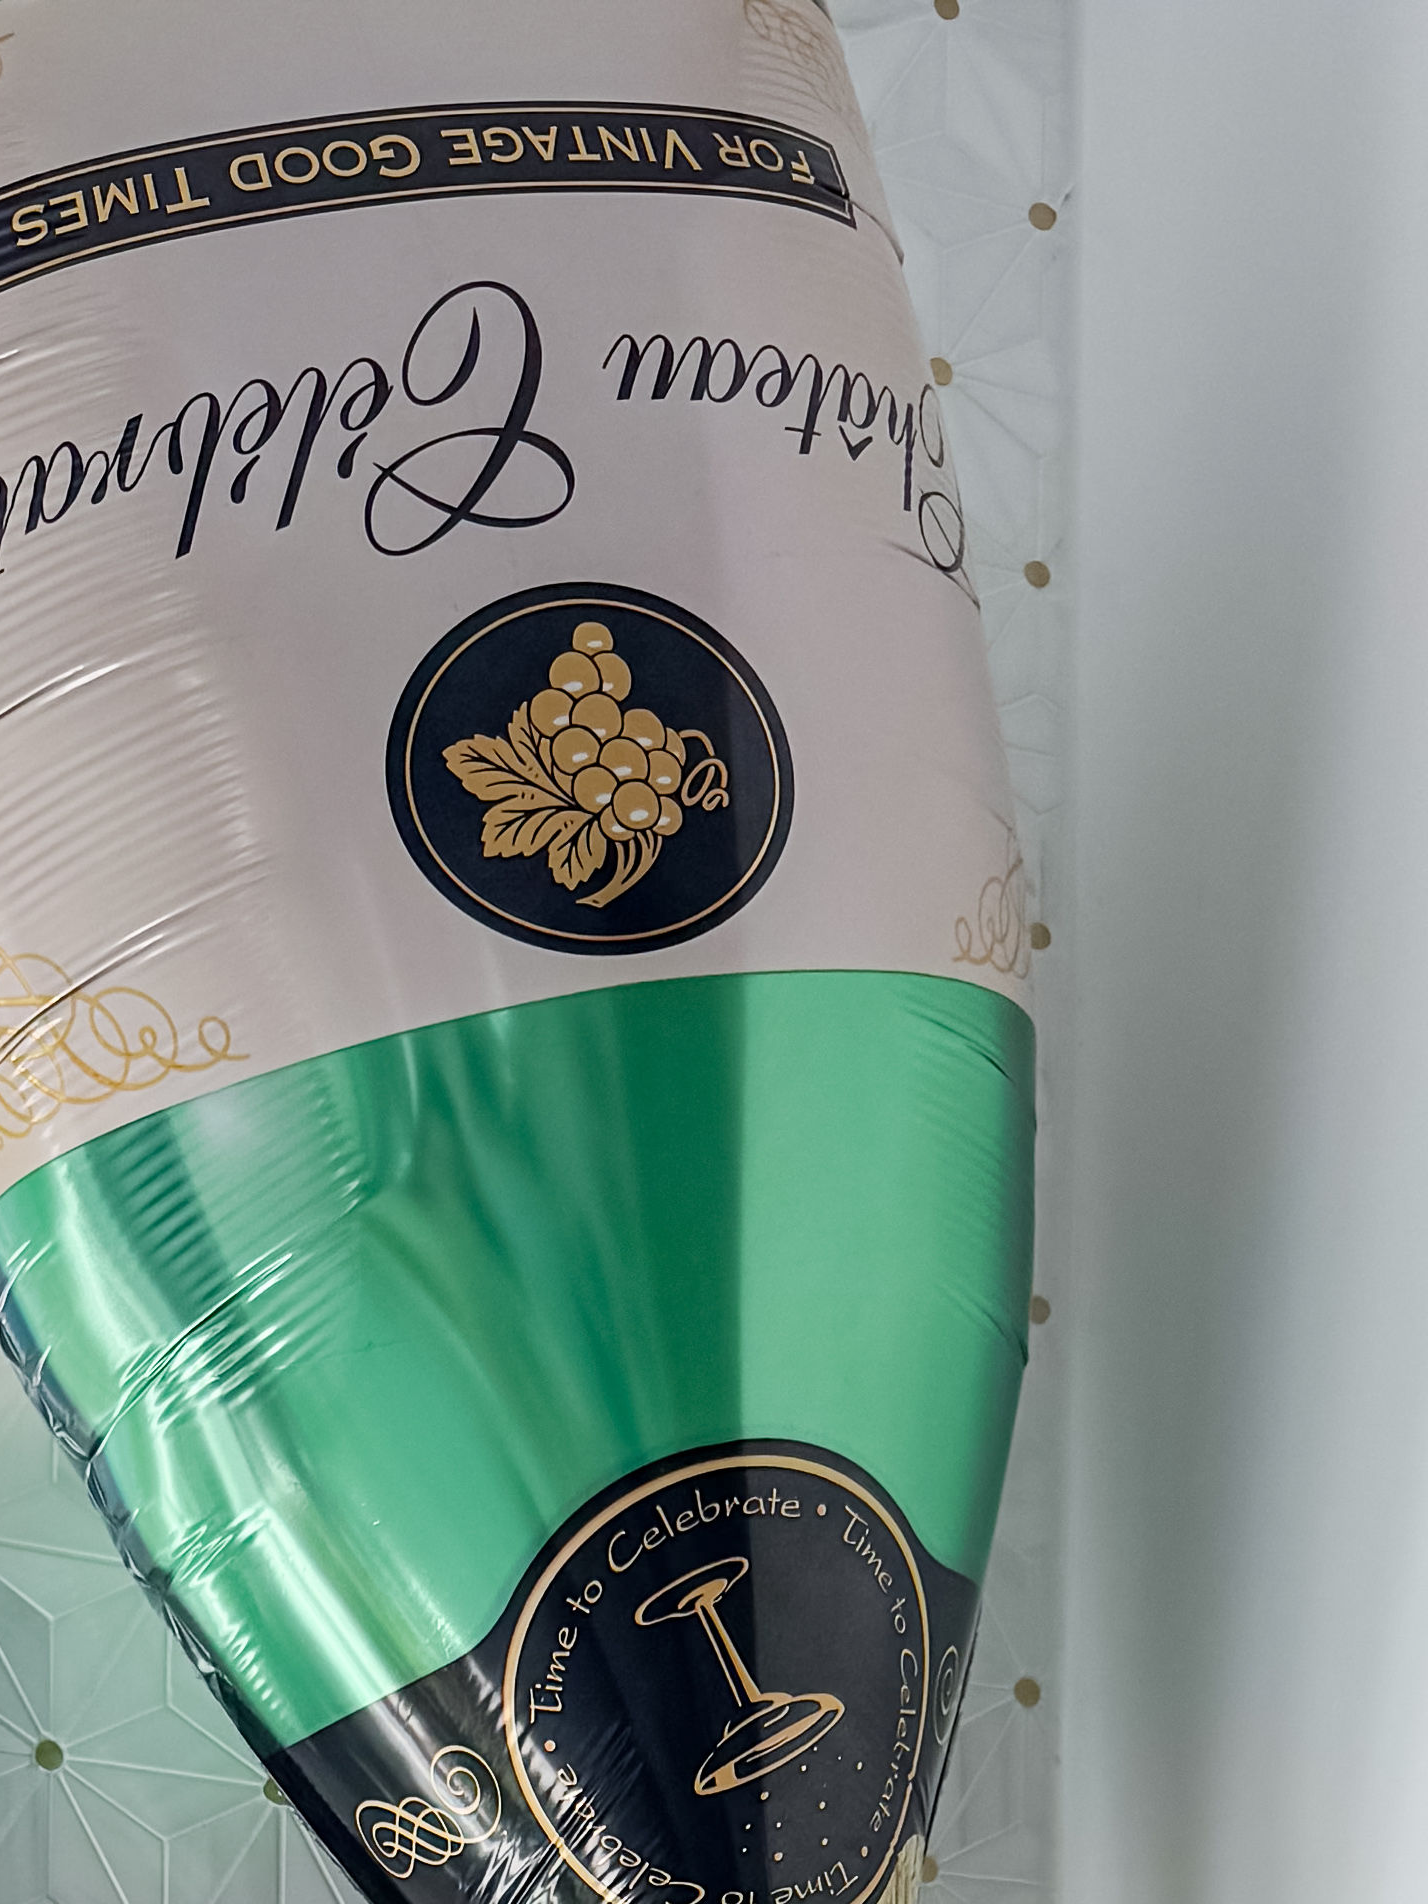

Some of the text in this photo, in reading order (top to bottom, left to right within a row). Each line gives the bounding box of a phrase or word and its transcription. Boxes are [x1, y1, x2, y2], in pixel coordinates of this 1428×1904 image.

[9, 123, 820, 248] FOR VINTAGE GOOD TIMES
[600, 330, 967, 576] Château
[528, 1489, 803, 1724] Time to Celebrate
[841, 1505, 919, 1834] Time to Celebrate
